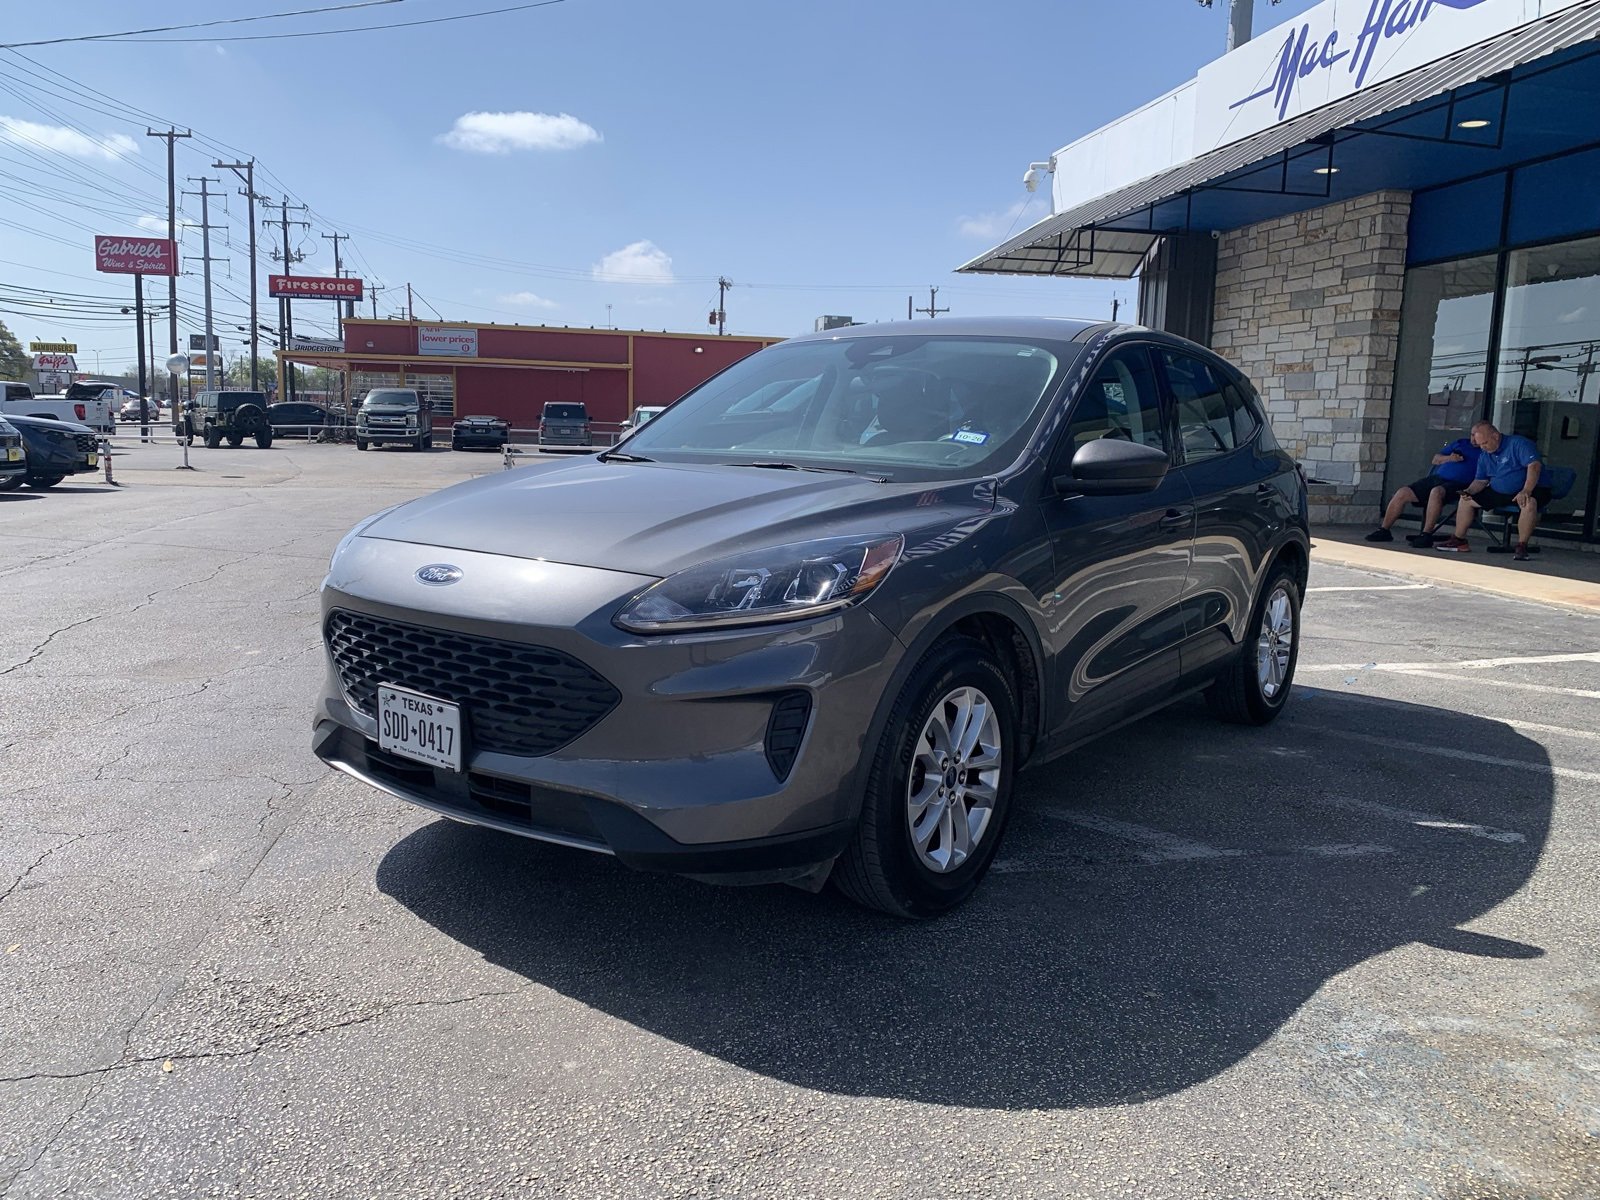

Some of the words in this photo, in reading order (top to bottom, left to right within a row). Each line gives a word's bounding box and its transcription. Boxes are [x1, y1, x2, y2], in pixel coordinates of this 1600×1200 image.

[1229, 23, 1350, 121] Mac
[98, 239, 168, 258] Gabriels
[102, 258, 125, 267] Wine
[135, 260, 166, 270] Spirits
[276, 278, 355, 292] Firestone
[422, 334, 448, 342] lower
[448, 335, 475, 344] prices
[32, 343, 73, 352] HAMBURGERS
[294, 344, 341, 353] BRIDGESTONE
[402, 696, 433, 716] TEXAS
